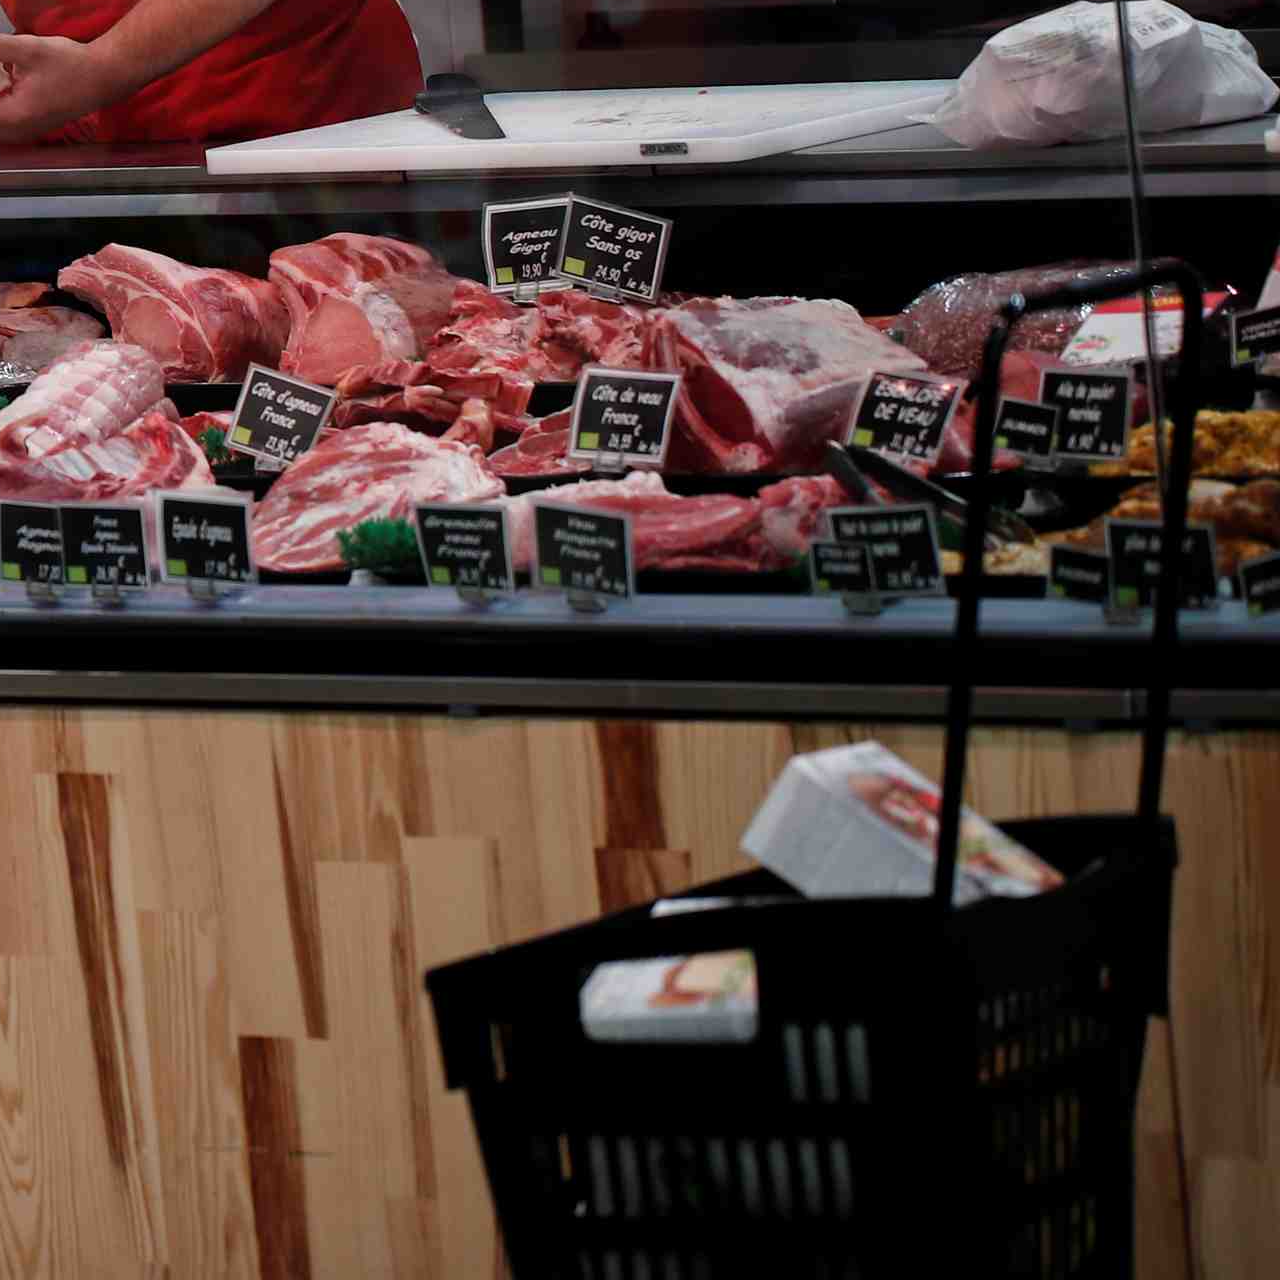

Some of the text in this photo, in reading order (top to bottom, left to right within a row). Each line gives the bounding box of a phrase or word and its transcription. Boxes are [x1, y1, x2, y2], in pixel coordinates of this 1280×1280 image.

[502, 228, 559, 244] Agneau
[580, 214, 656, 244] Côte gigot
[509, 241, 551, 256] Gigot
[585, 235, 643, 260] Sans os
[522, 263, 542, 279] 19,90
[594, 264, 621, 282] 24,90
[251, 382, 322, 417] Côte d'agneau
[592, 383, 663, 405] Côte de veau
[260, 406, 296, 429] France
[601, 407, 639, 426] France
[872, 402, 938, 428] DE VEAU
